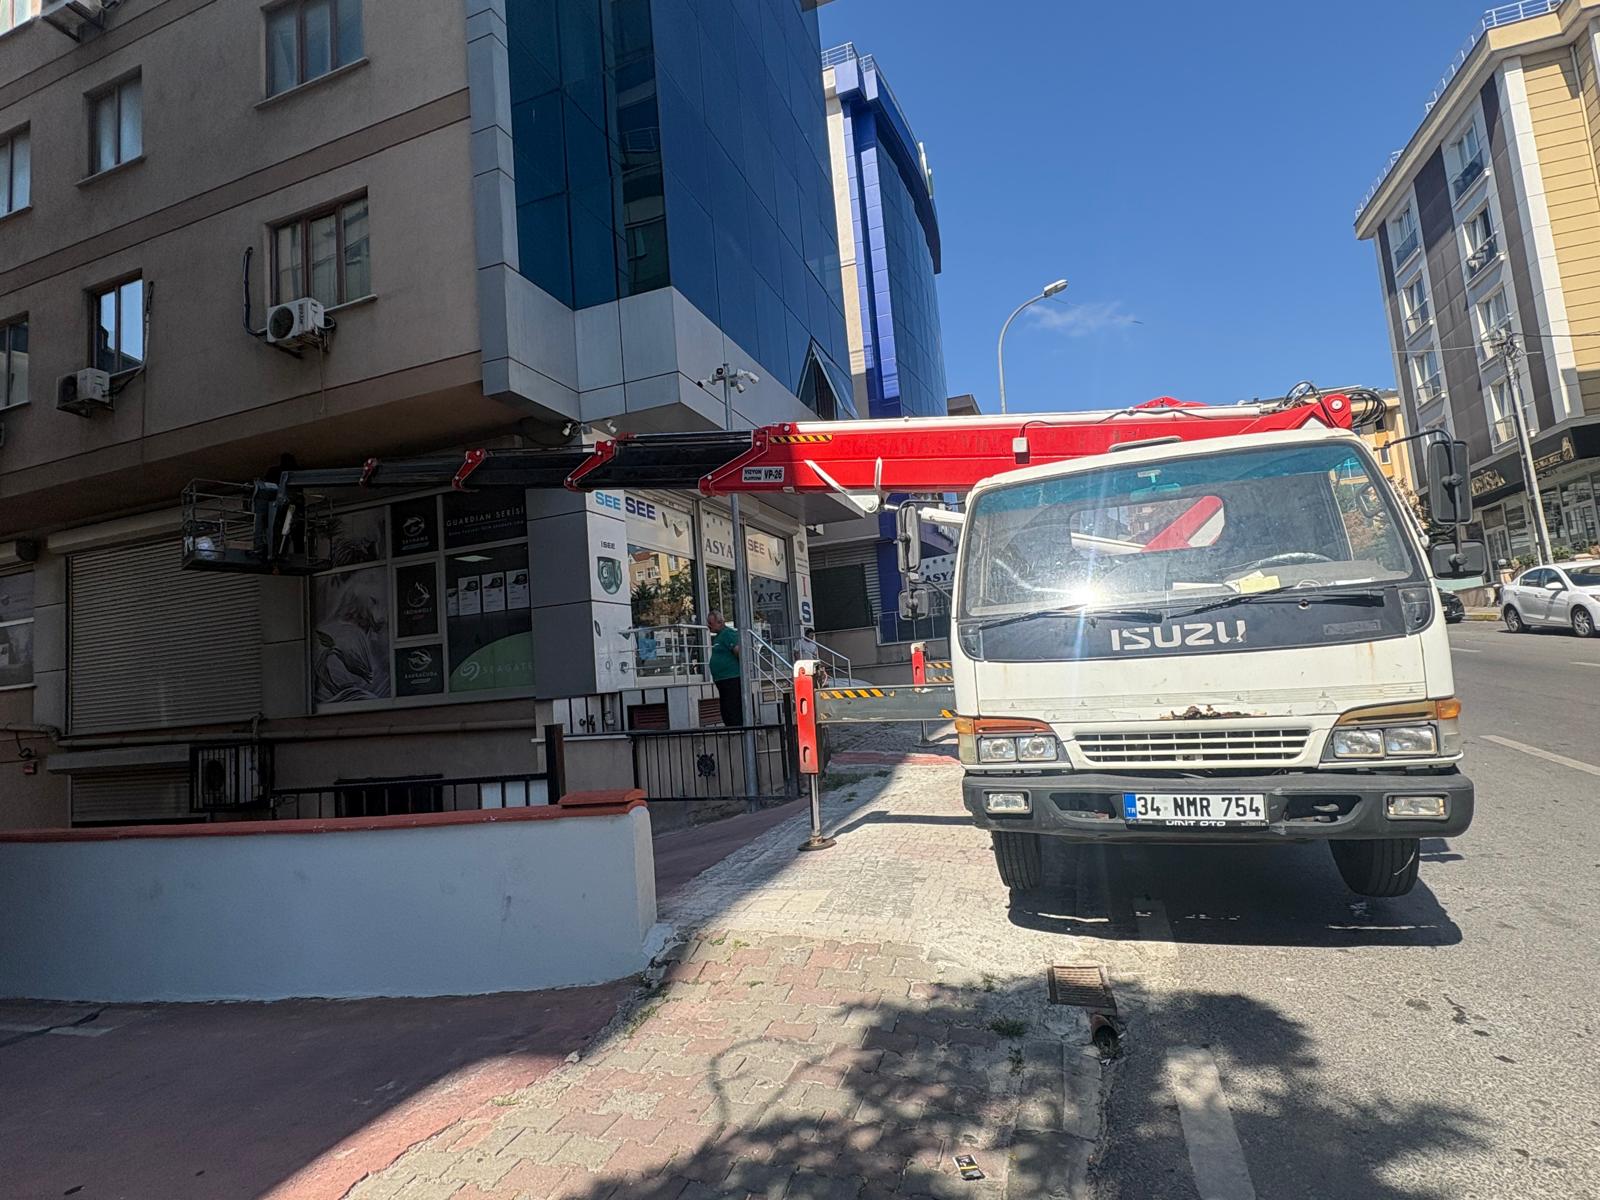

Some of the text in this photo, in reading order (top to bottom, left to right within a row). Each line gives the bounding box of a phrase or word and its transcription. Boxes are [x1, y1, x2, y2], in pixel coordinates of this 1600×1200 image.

[764, 469, 783, 480] VP-26
[625, 496, 656, 521] SEE
[446, 512, 492, 527] GUARDIAN
[705, 537, 734, 559] ASYA
[747, 538, 765, 556] SEE
[1110, 620, 1247, 651] ISUZU
[1137, 796, 1261, 817] 34 NMR 754
